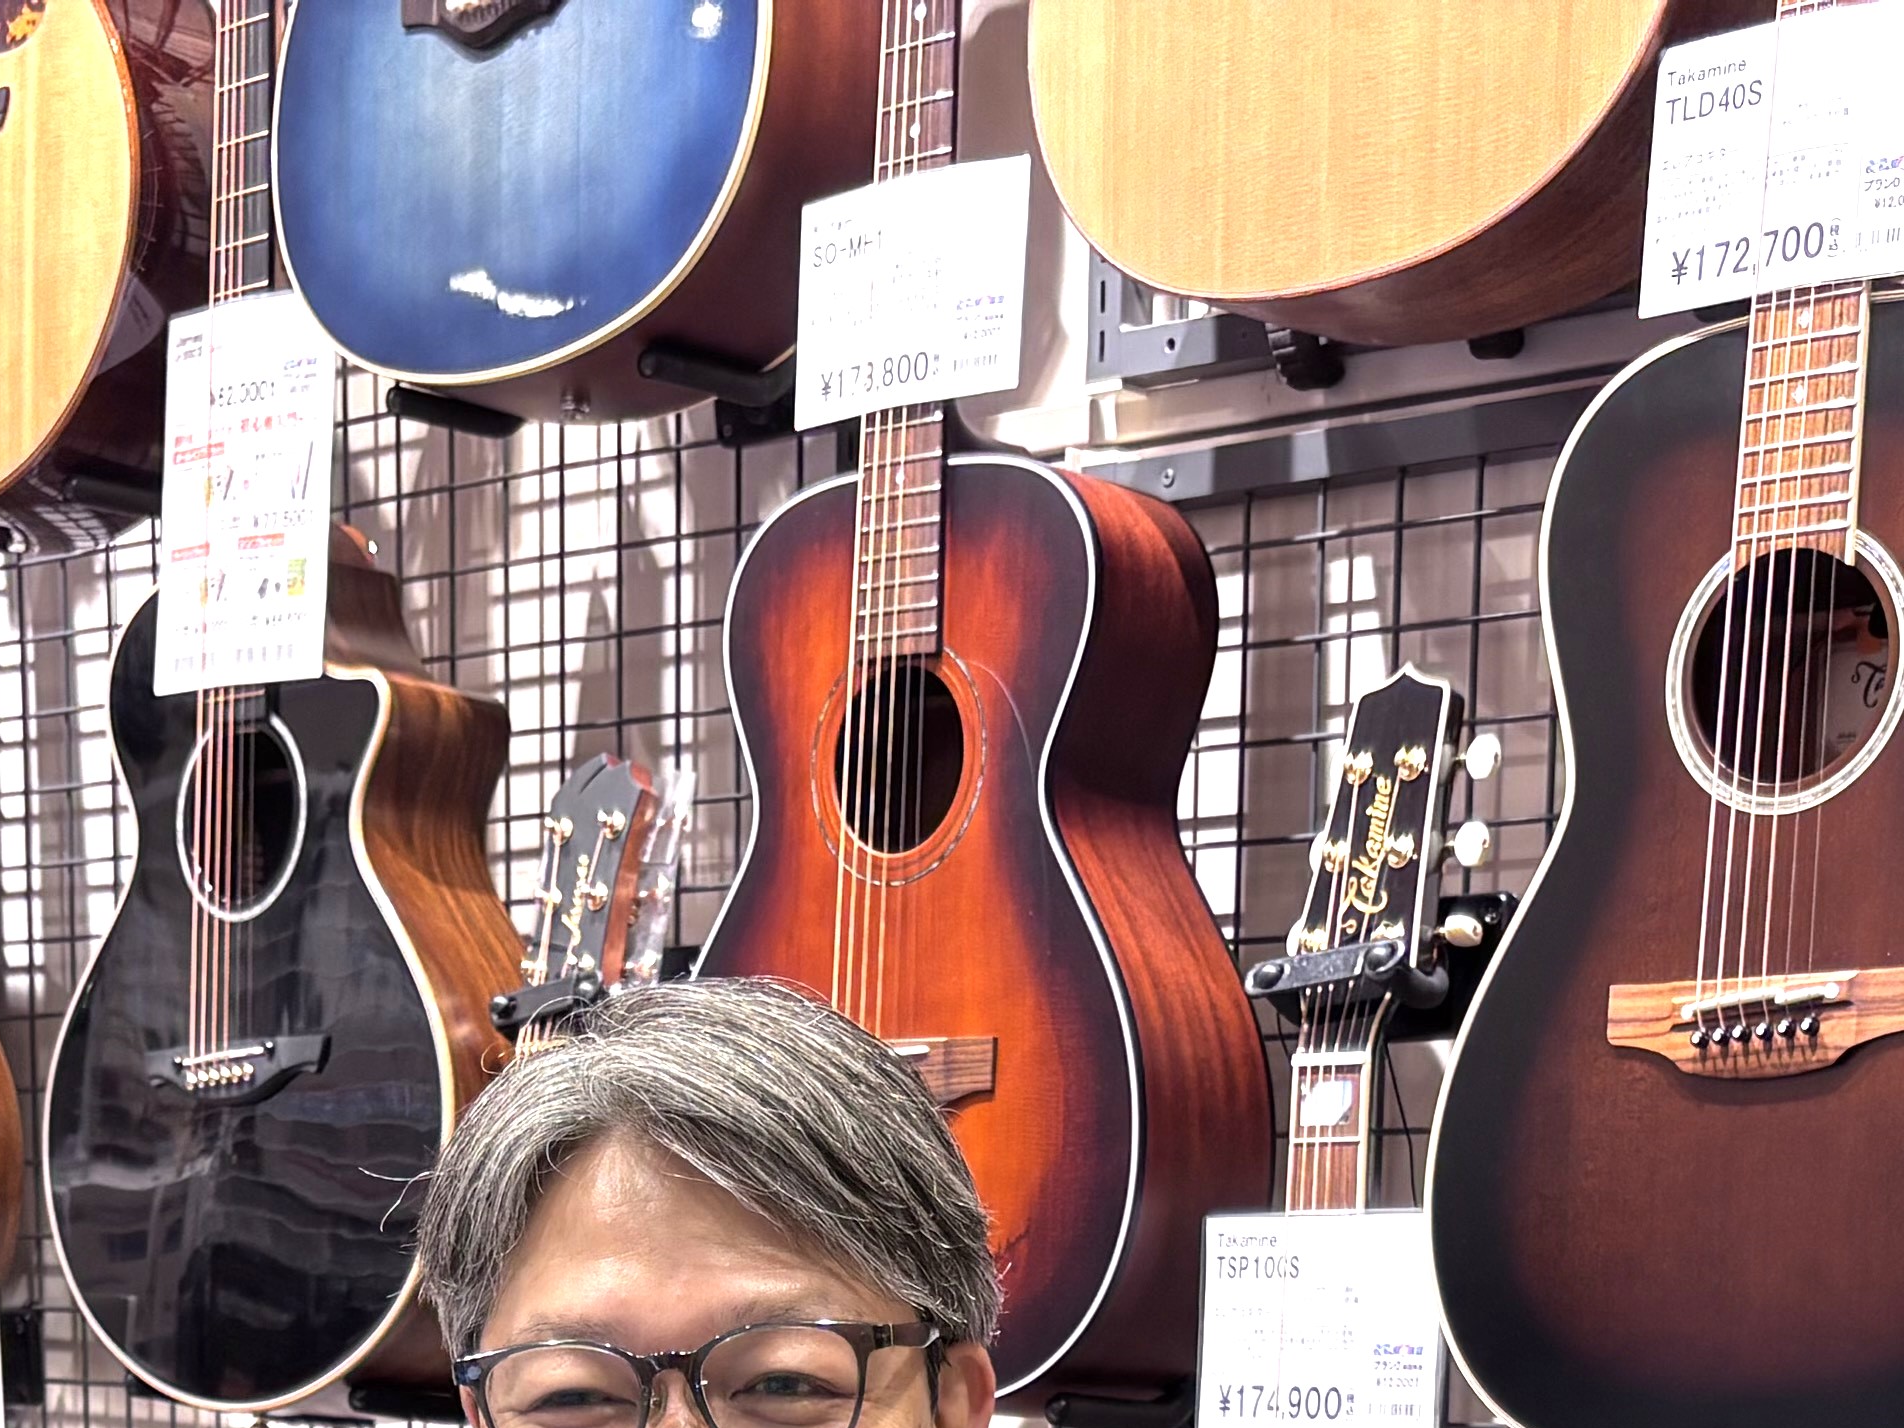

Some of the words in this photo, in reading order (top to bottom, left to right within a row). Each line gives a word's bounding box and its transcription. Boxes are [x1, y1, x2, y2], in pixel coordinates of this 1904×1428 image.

[1667, 59, 1748, 87] Takamine
[1666, 79, 1764, 125] TLD40S
[1671, 221, 1824, 285] ¥172,700
[821, 351, 929, 402] ¥173,800
[1340, 775, 1392, 934] Takamine
[1218, 1383, 1343, 1420] ¥174,900
